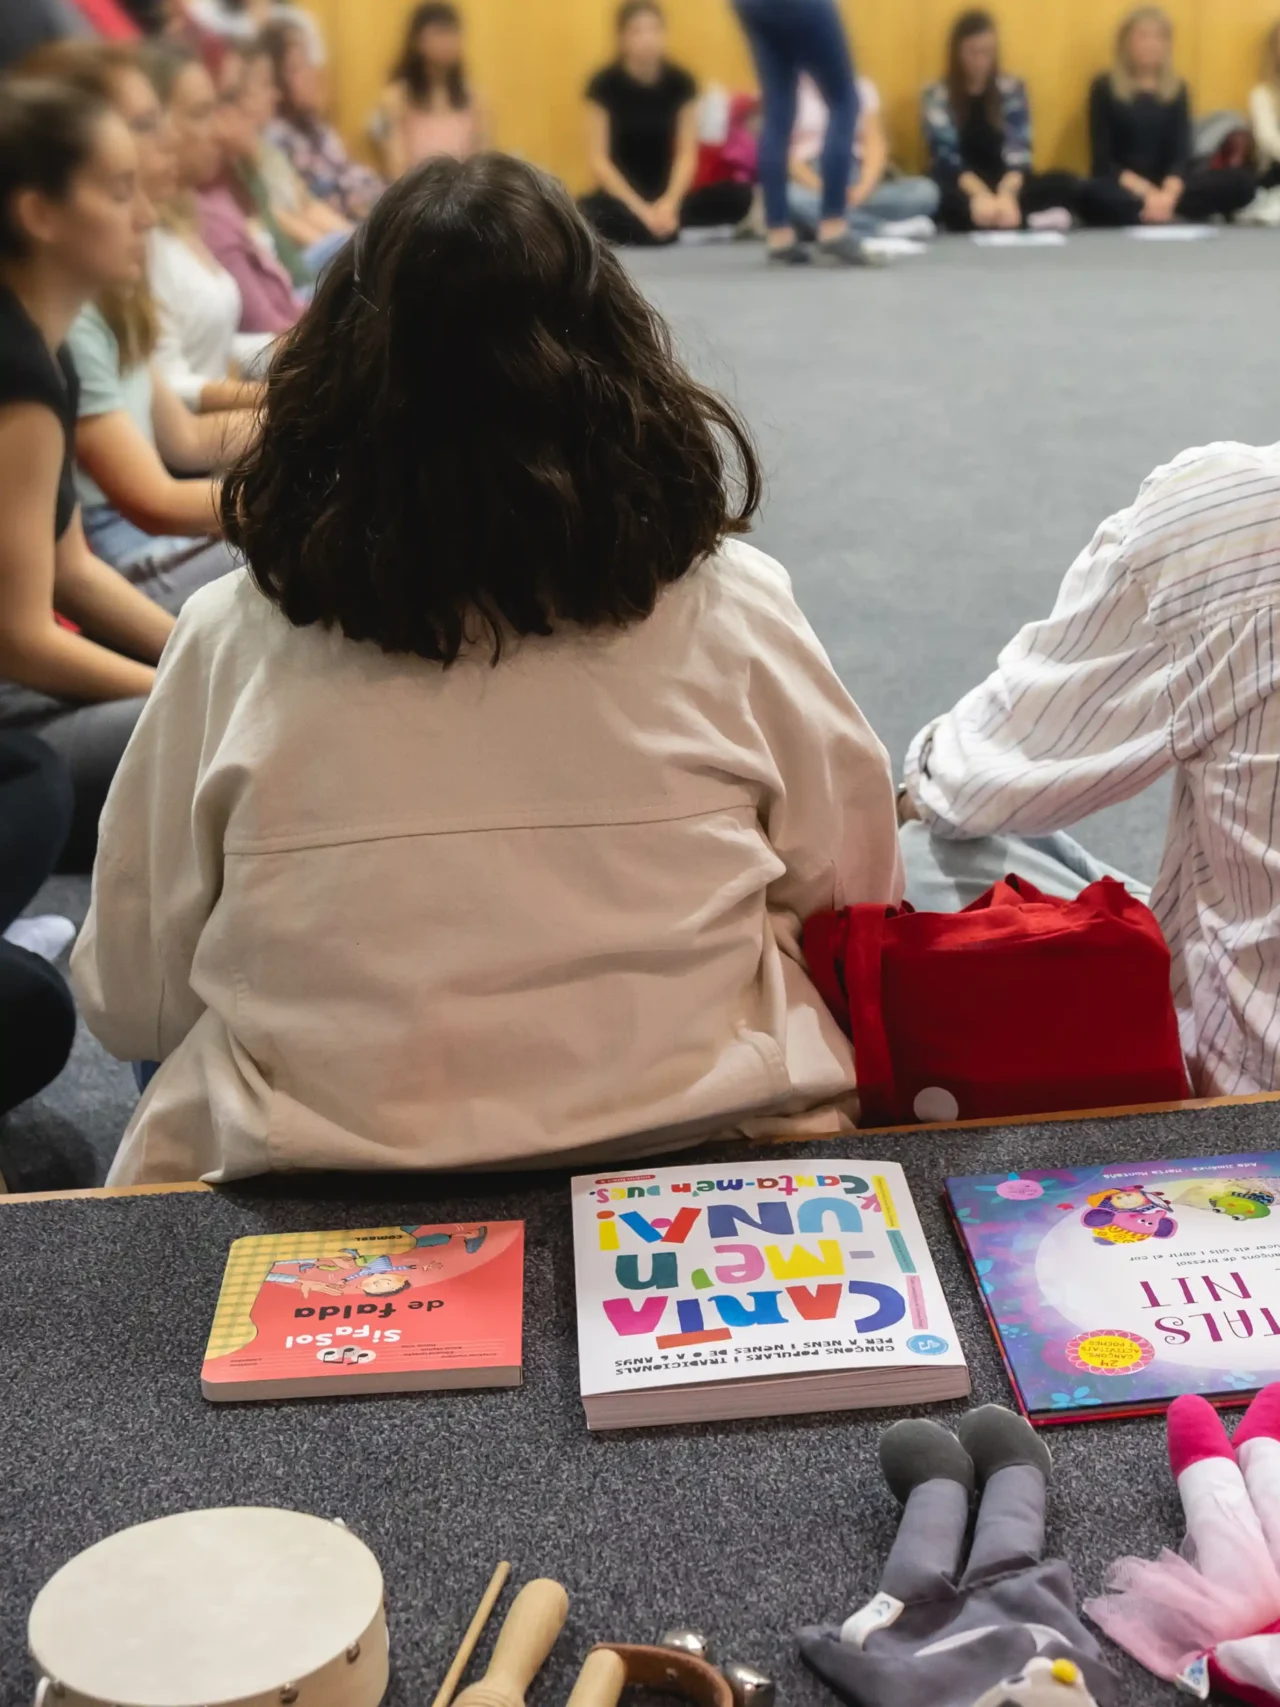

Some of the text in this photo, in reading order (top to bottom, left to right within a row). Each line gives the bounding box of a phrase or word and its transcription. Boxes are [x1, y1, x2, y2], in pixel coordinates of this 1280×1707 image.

[596, 1197, 863, 1251] UNA!
[1168, 1251, 1196, 1259] obrir
[1176, 1258, 1218, 1267] bressol
[1139, 1272, 1252, 1309] NIT
[294, 1300, 444, 1320] de falda
[803, 1340, 842, 1348] NENS
[825, 1345, 895, 1354] CANÇONS
[746, 1350, 819, 1361] POPULARS
[1081, 1346, 1139, 1354] ACTIVITATS
[614, 1356, 653, 1367] ANYS
[616, 1357, 727, 1376] TRADICIONALS
